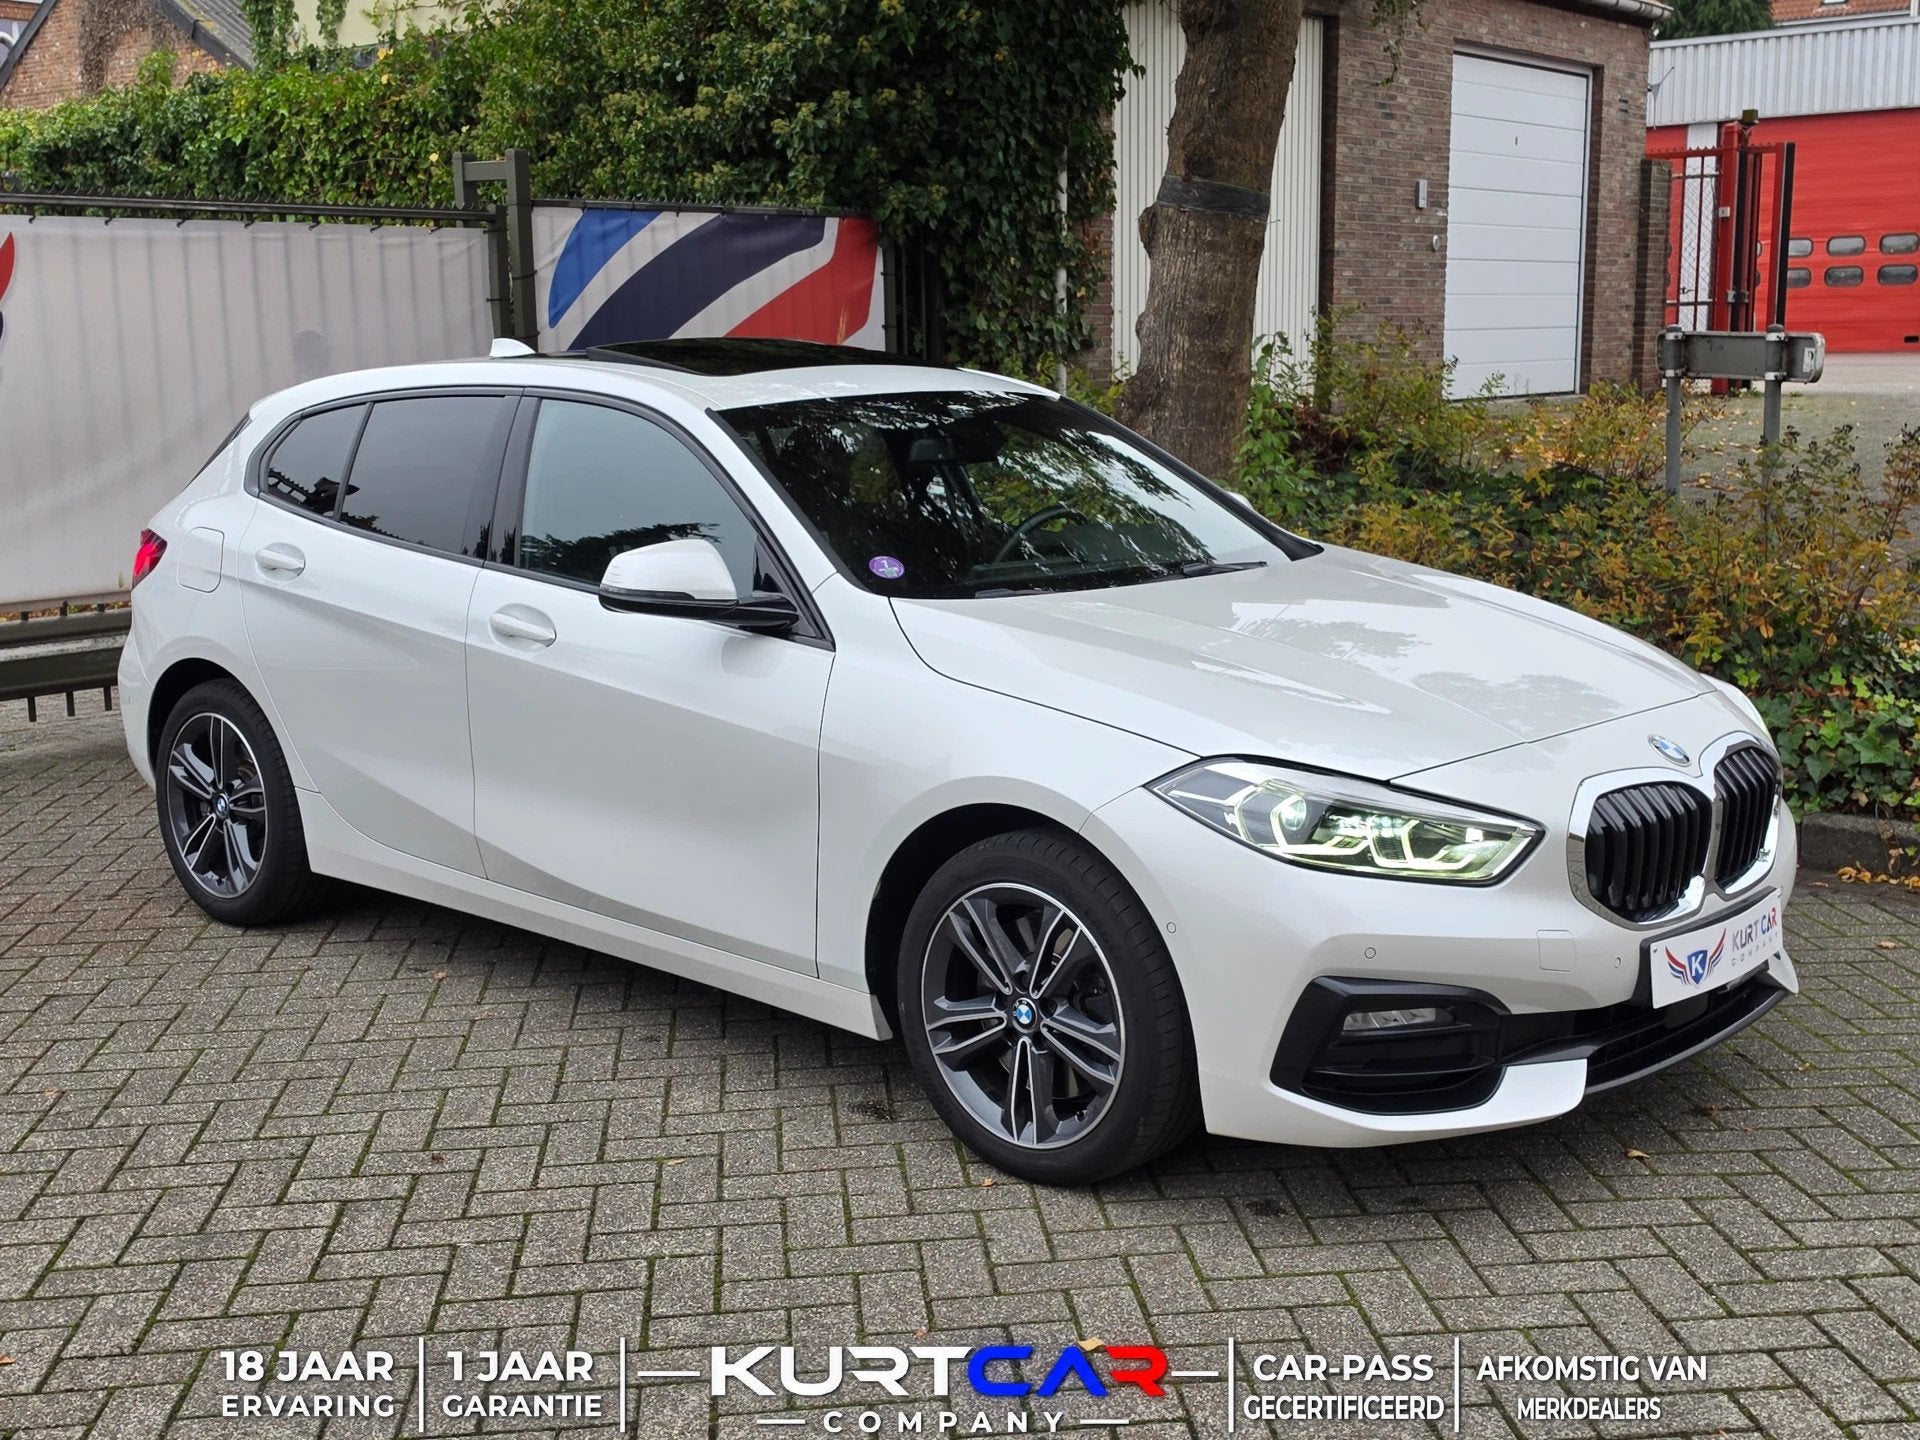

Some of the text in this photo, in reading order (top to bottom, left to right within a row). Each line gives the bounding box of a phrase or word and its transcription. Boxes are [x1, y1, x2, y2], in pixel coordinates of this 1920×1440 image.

[1732, 907, 1777, 952] KURT CAR
[1690, 953, 1704, 977] K
